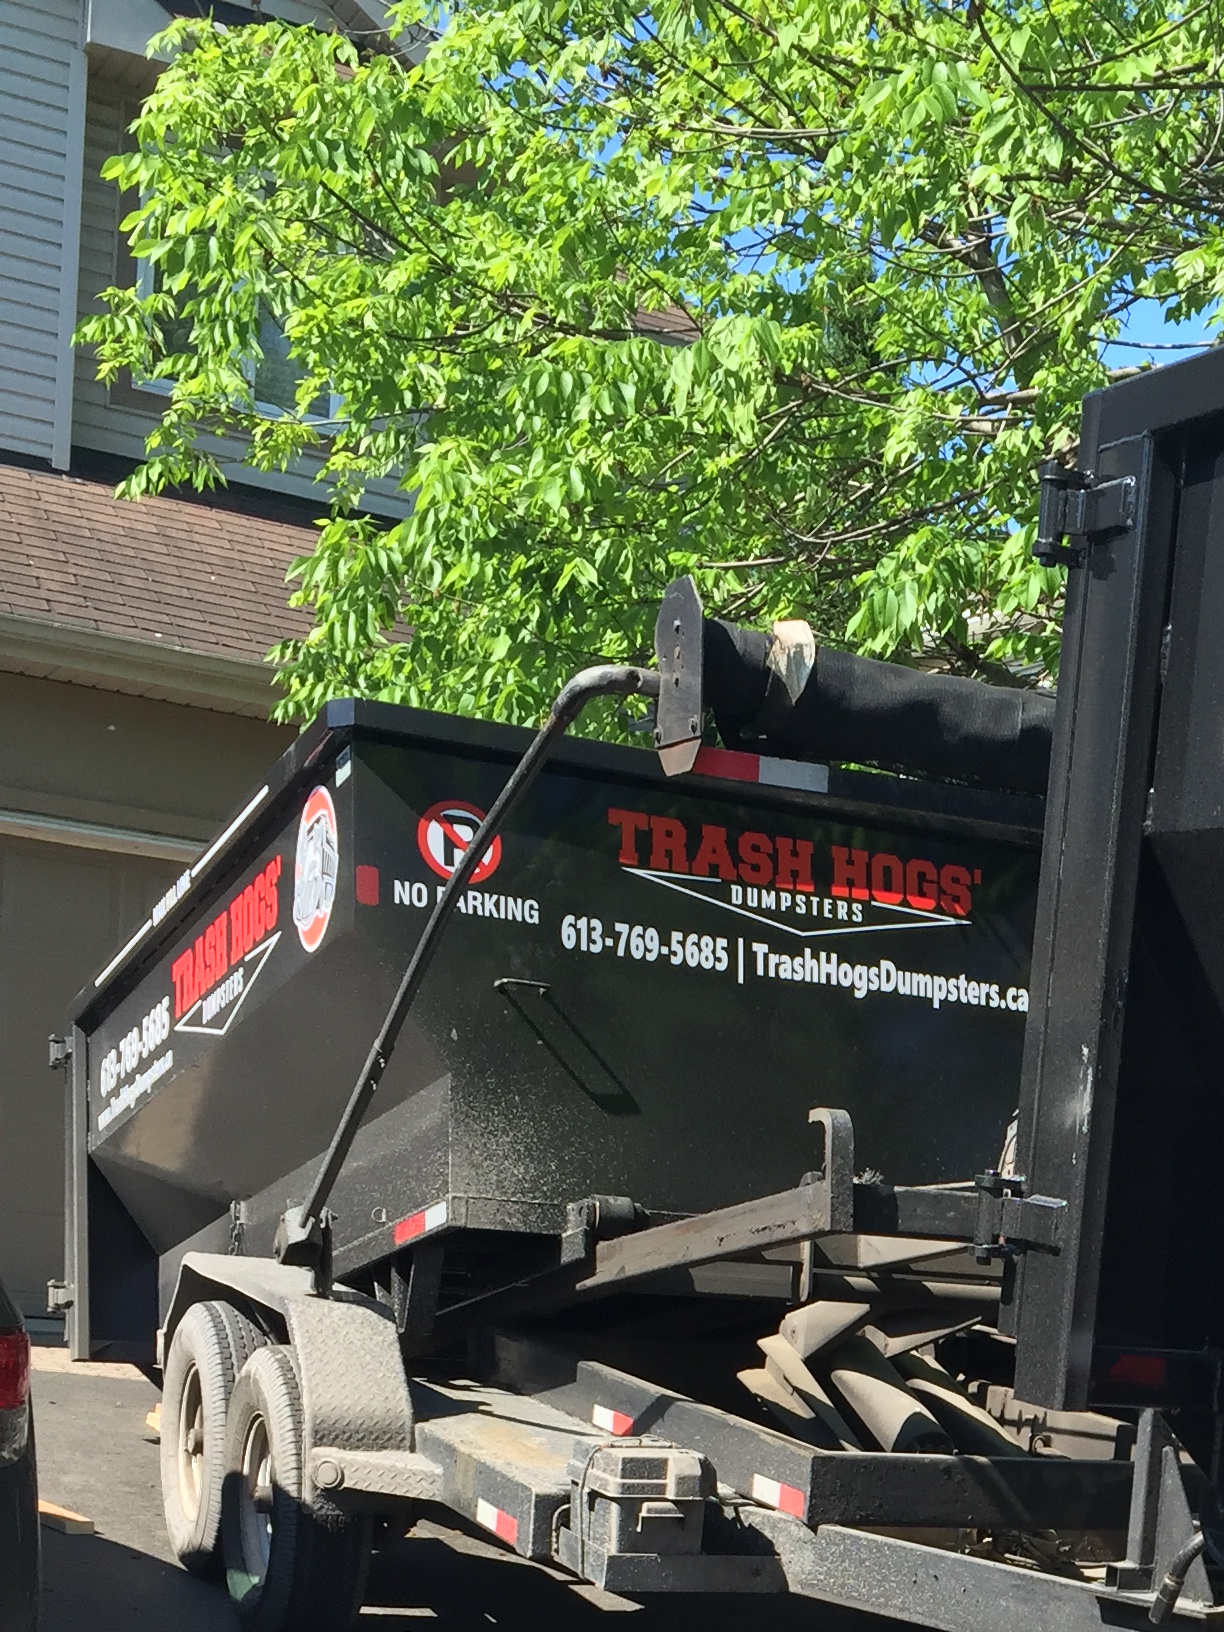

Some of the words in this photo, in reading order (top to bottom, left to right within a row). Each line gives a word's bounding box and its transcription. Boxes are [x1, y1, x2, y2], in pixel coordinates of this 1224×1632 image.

[393, 879, 428, 908] NO
[607, 807, 814, 893] TRASH
[831, 844, 982, 917] HOGS'
[730, 883, 864, 924] DUMPSTERS
[171, 911, 228, 1019] TRASH
[560, 914, 729, 972] 613-769-5685
[752, 941, 1030, 1013] TrashHogsDumpsters.ca
